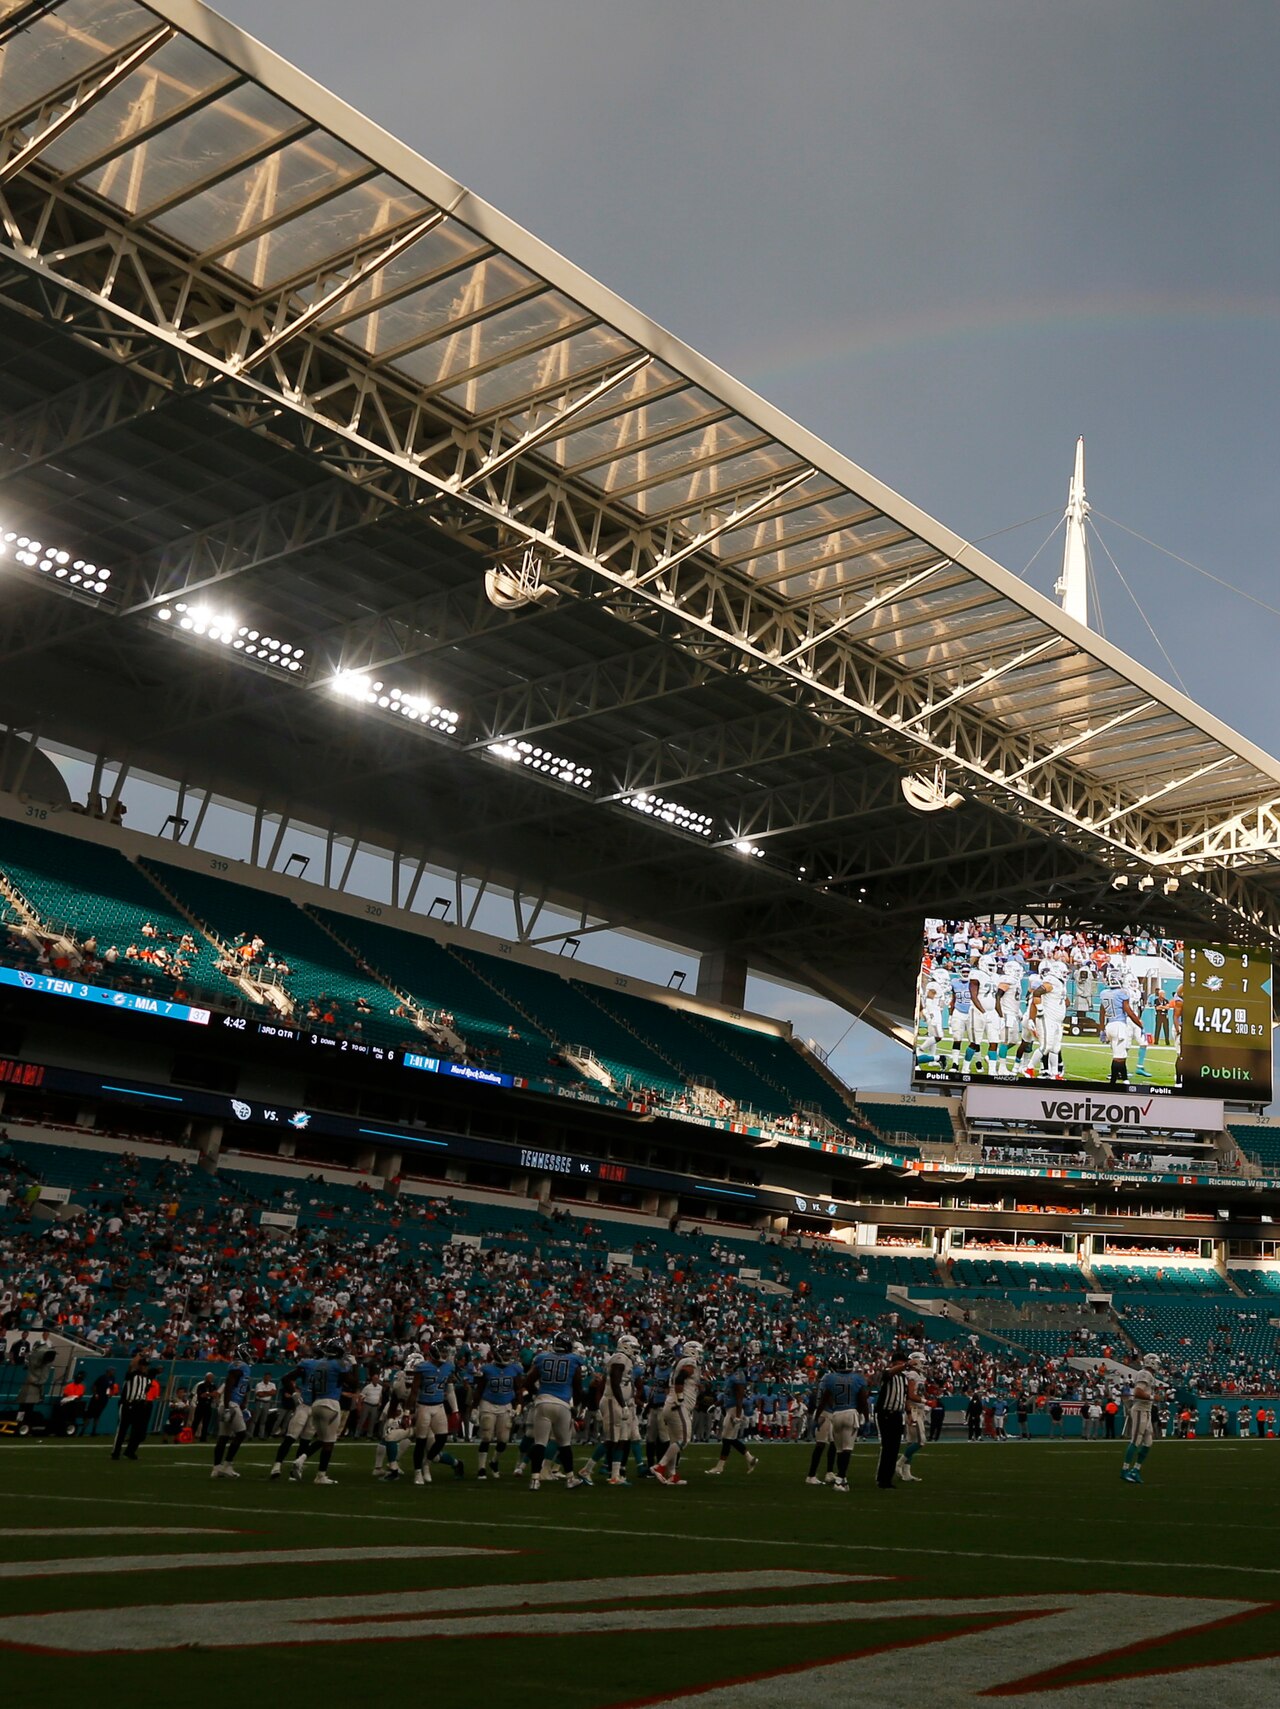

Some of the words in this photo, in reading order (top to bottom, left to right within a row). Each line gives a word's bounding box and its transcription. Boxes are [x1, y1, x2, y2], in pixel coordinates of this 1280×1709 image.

[25, 806, 47, 820] 318
[210, 859, 229, 872] 319
[365, 904, 382, 917] 320
[499, 943, 512, 954] 321
[1242, 954, 1248, 968] 3
[46, 979, 74, 994] TEN
[80, 986, 89, 997] 3
[615, 976, 628, 988] 322
[1242, 979, 1248, 993] 7
[134, 997, 158, 1012] MIA
[164, 1003, 173, 1014] 7
[192, 1010, 206, 1021] 37
[1194, 1006, 1232, 1034] 4:42
[223, 1016, 247, 1030] 4:42
[261, 1026, 276, 1036] 3RD
[278, 1028, 294, 1038] QTR
[311, 1034, 318, 1045] 3
[320, 1038, 336, 1046] DOWN
[341, 1041, 348, 1051] 2
[372, 1046, 384, 1054] BALL
[1235, 1023, 1248, 1034] 3RD
[1258, 1025, 1263, 1036] 2
[388, 1050, 394, 1060] 6
[409, 1054, 423, 1067] 7:01
[424, 1058, 434, 1070] PM
[450, 1065, 466, 1075] Hard
[466, 1066, 478, 1080] Rock
[478, 1071, 502, 1084] Stadium
[926, 1072, 950, 1080] Publix
[1201, 1065, 1250, 1080] Publix
[558, 1086, 576, 1098] DON
[578, 1091, 600, 1104] SHULA
[605, 1099, 618, 1108] 347
[1150, 1087, 1172, 1095] Publix
[900, 1095, 916, 1104] 324
[1041, 1098, 1140, 1124] verizon
[652, 1108, 668, 1118] NICK
[714, 1120, 725, 1130] 85
[1256, 1116, 1270, 1124] 327
[520, 1150, 572, 1174] TENNESSEE
[884, 1155, 892, 1164] 66
[944, 1164, 976, 1174] DWIGHT
[978, 1166, 1028, 1176] STEPHENSON
[1030, 1169, 1040, 1177] 57
[1081, 1172, 1096, 1180] BOB
[1098, 1172, 1148, 1182] KUECHENBERG
[1208, 1178, 1246, 1187] RICHMOND
[1248, 1180, 1268, 1188] WEBB
[1271, 1180, 1280, 1188] 78
[542, 1358, 570, 1384] 90
[422, 1375, 448, 1394] 24
[490, 1377, 514, 1394] 99
[834, 1383, 851, 1406] 21
